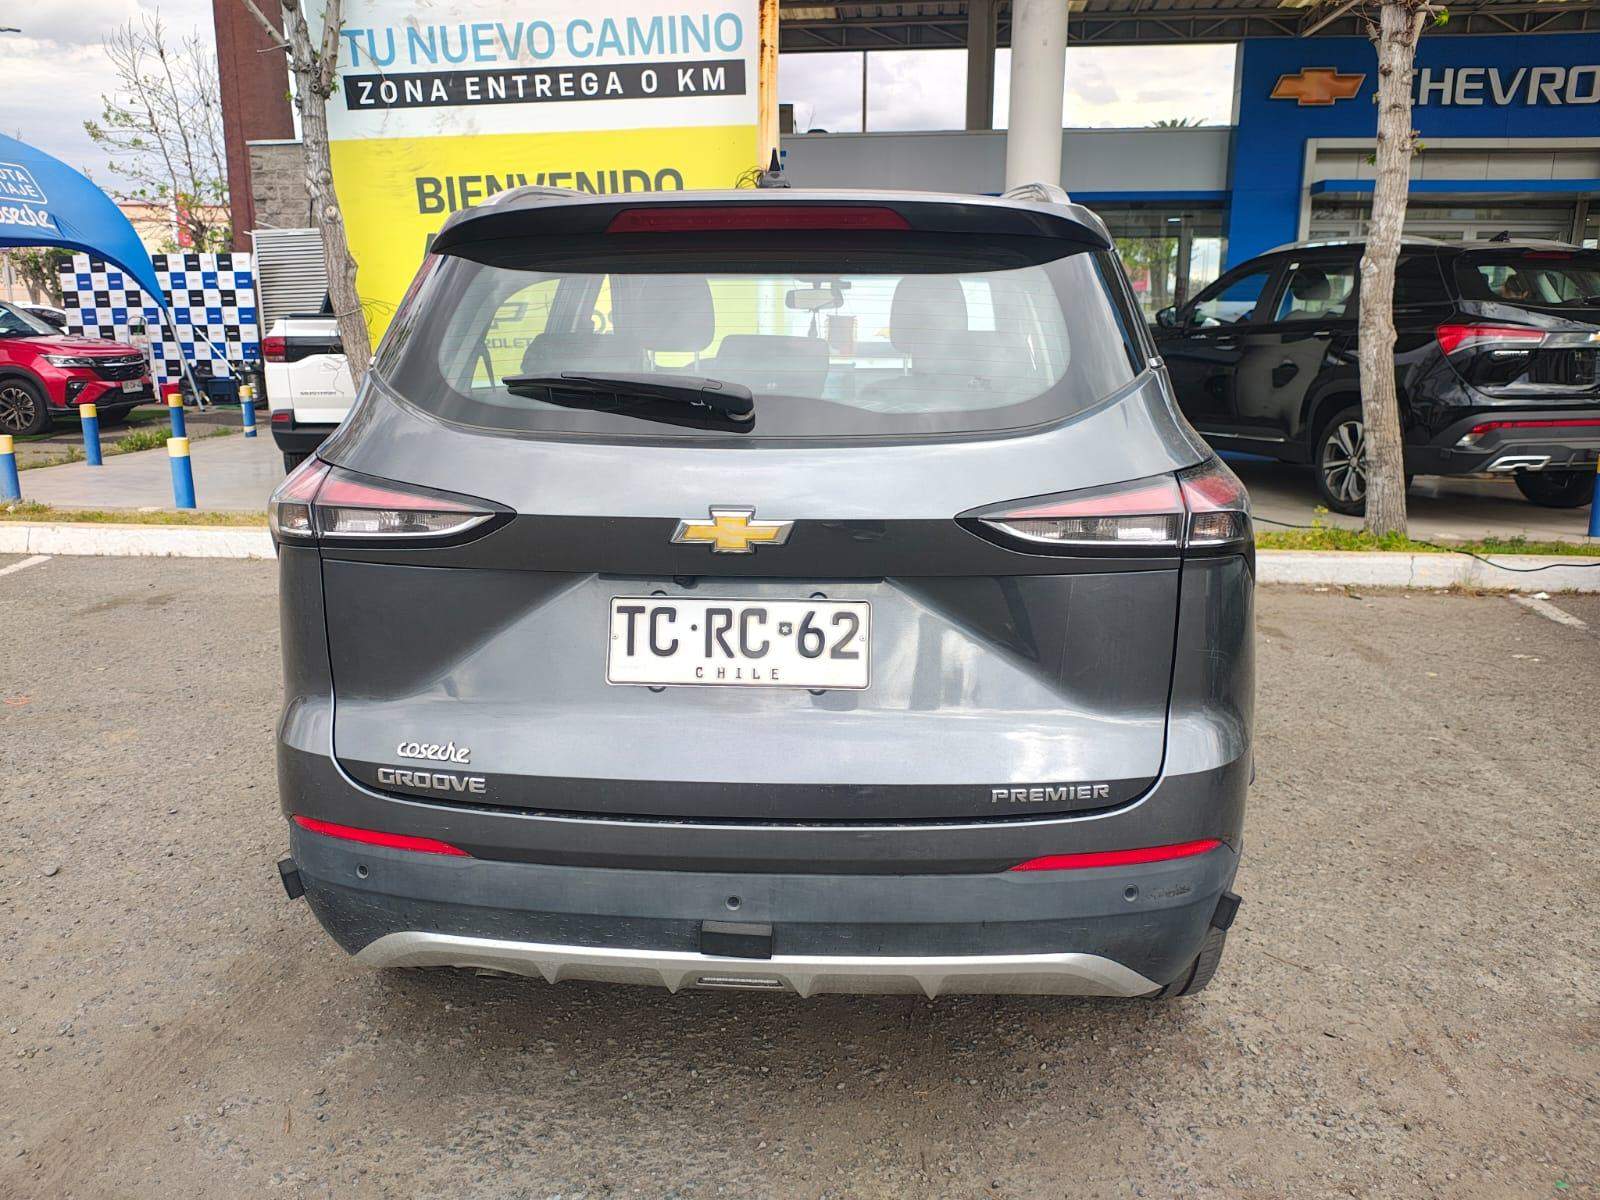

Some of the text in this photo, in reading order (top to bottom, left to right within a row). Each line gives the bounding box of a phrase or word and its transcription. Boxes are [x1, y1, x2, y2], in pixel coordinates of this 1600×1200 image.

[340, 12, 744, 67] TU NUEVO CAMINO
[357, 78, 449, 105] ZONA
[465, 71, 624, 100] ENTREGA
[677, 67, 726, 92] KM
[1411, 64, 1600, 105] HEVRO
[695, 666, 780, 681] CHILE
[377, 767, 487, 794] GROOVE
[991, 784, 1110, 803] PREMIER
